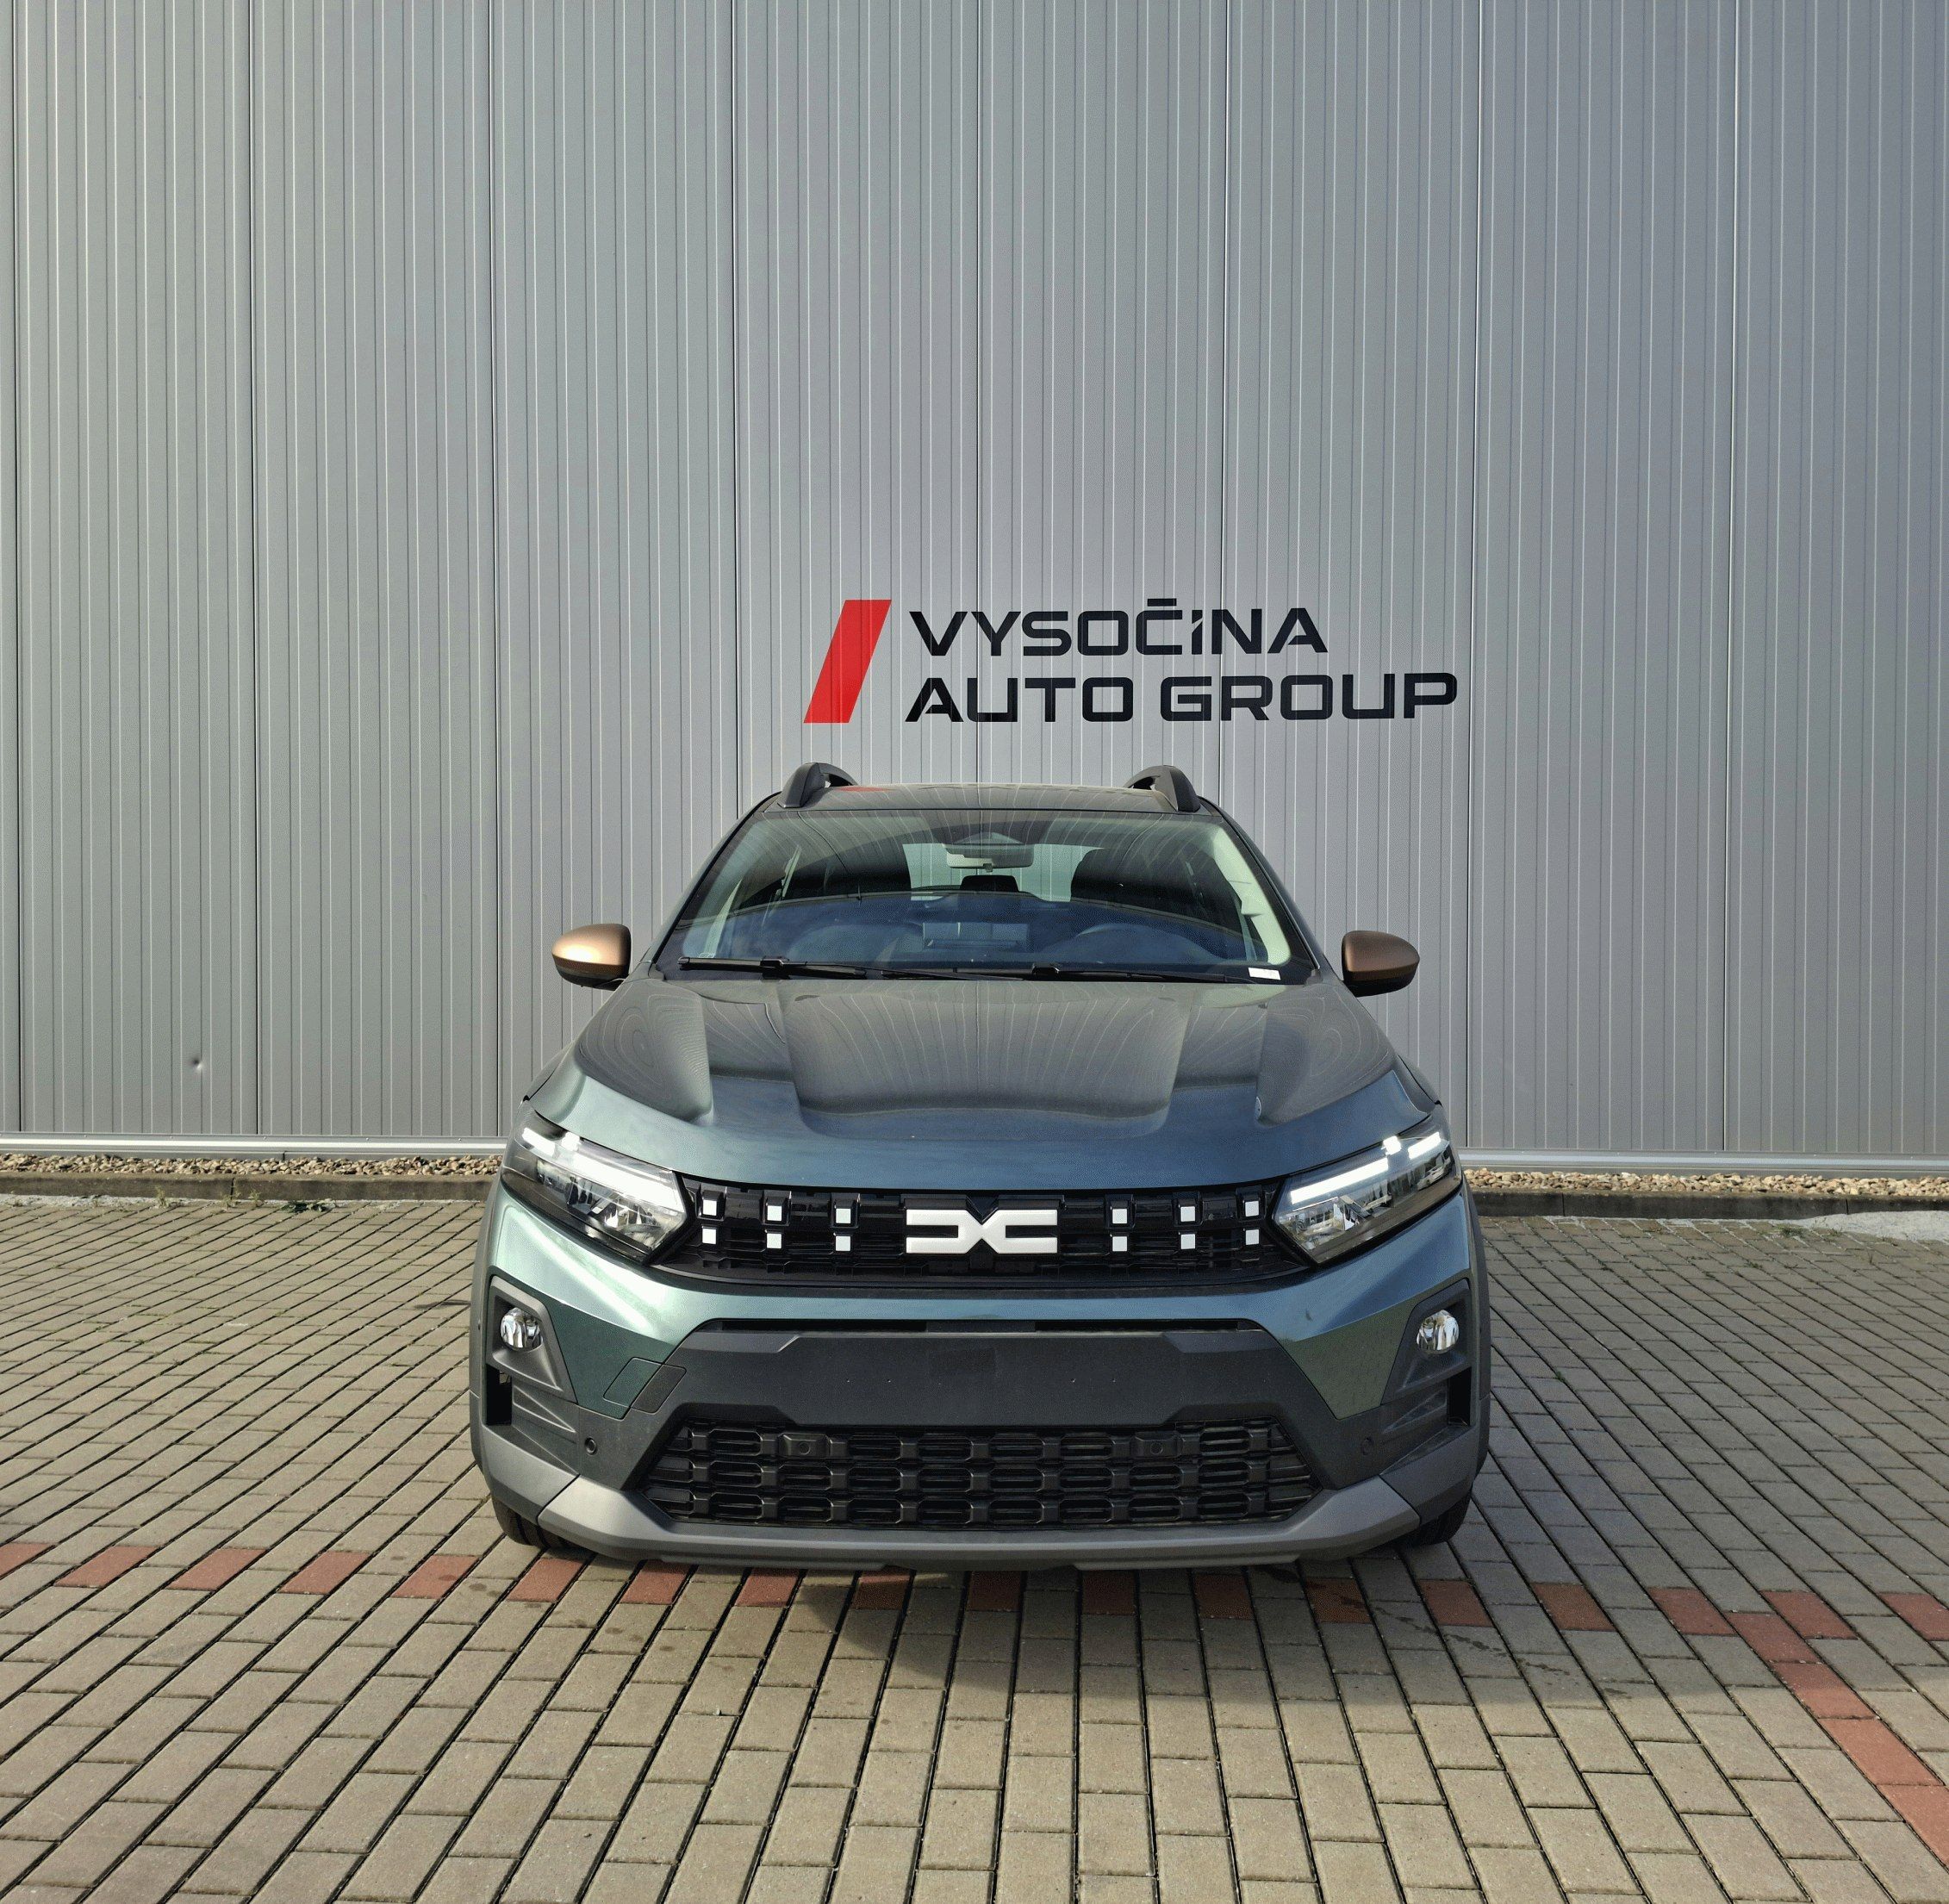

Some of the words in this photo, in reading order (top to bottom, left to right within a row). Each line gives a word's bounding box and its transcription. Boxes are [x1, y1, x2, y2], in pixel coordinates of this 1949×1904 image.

[909, 598, 1329, 656] VYSOČINA
[905, 676, 1134, 723] AUTO
[1160, 672, 1458, 722] GROUP
